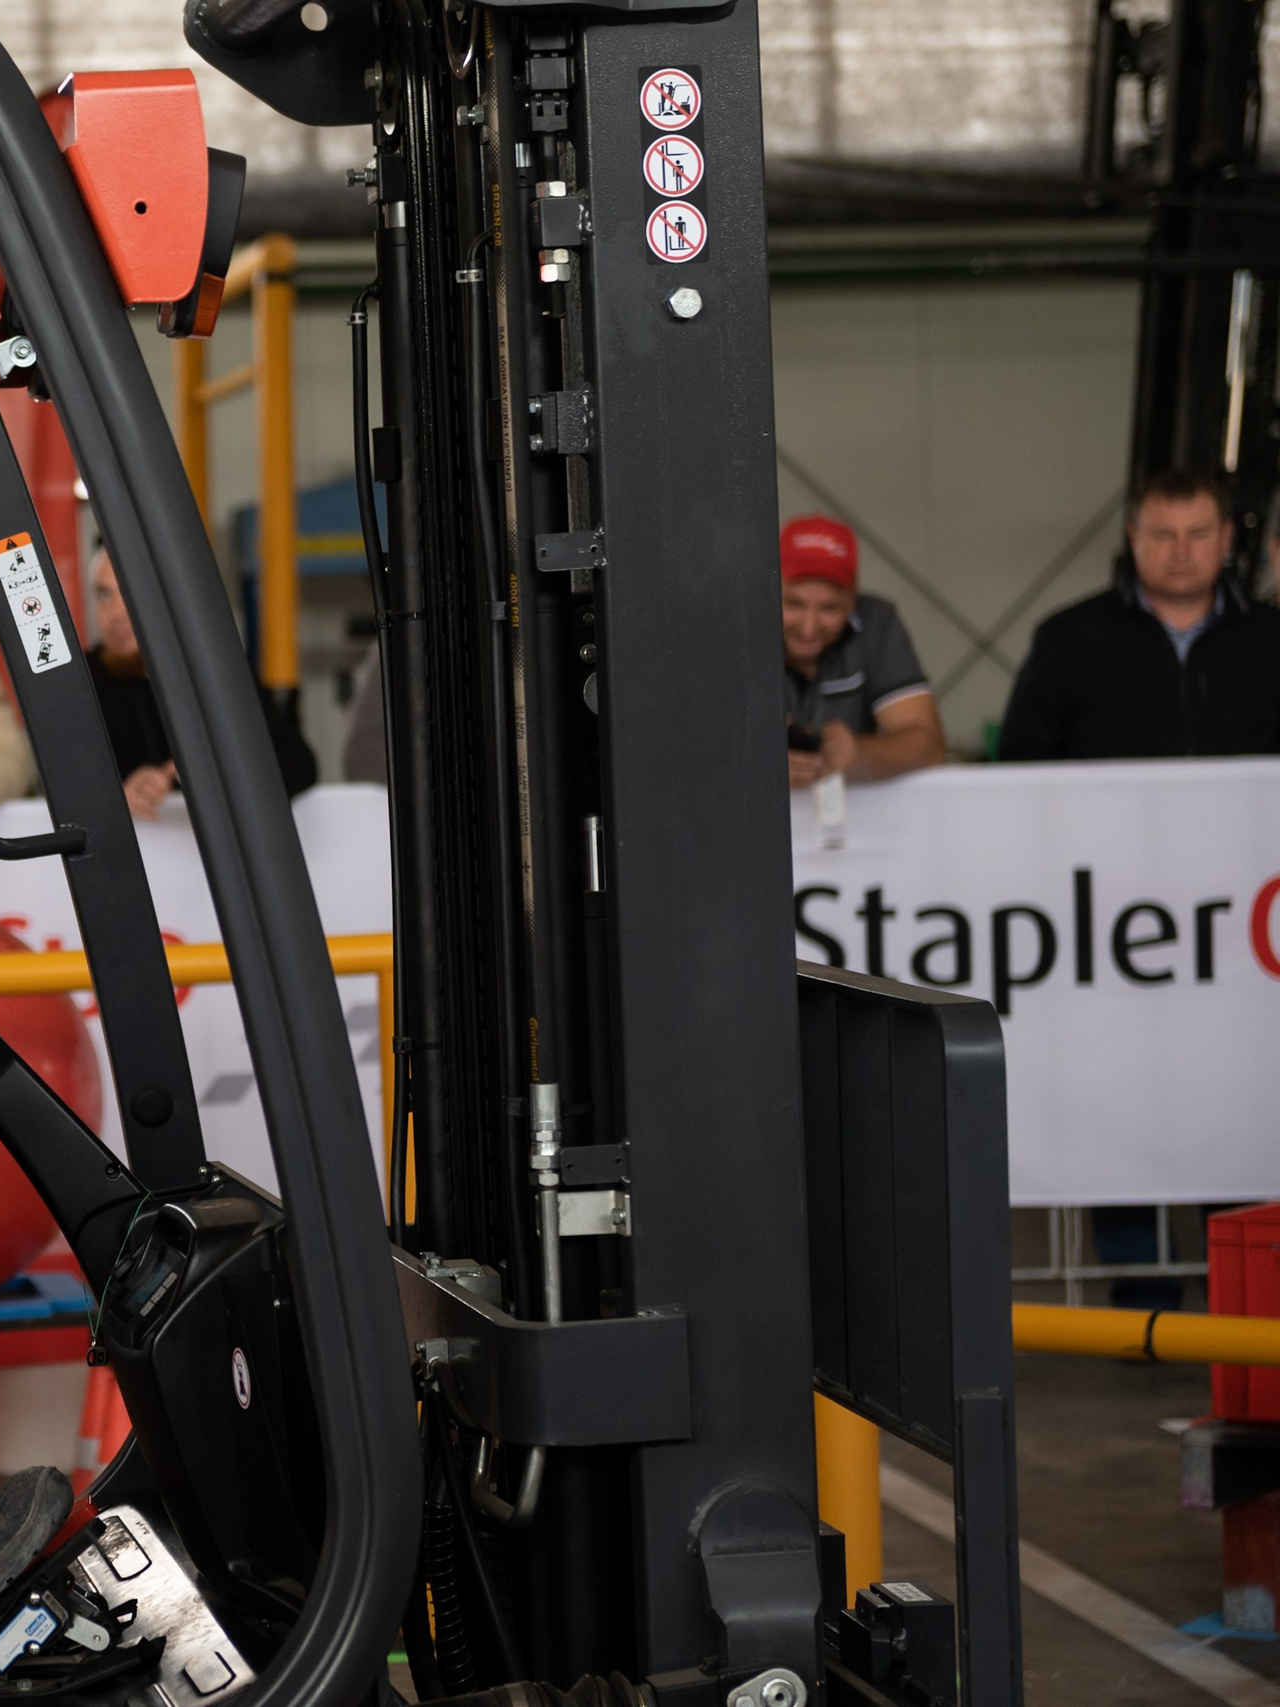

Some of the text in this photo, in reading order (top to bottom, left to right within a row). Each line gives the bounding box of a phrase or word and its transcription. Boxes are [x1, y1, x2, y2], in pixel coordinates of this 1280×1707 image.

[491, 184, 502, 247] SR2SN-08
[498, 325, 506, 349] SAE
[509, 573, 520, 628] 4000 PSI
[529, 1017, 539, 1082] Continental
